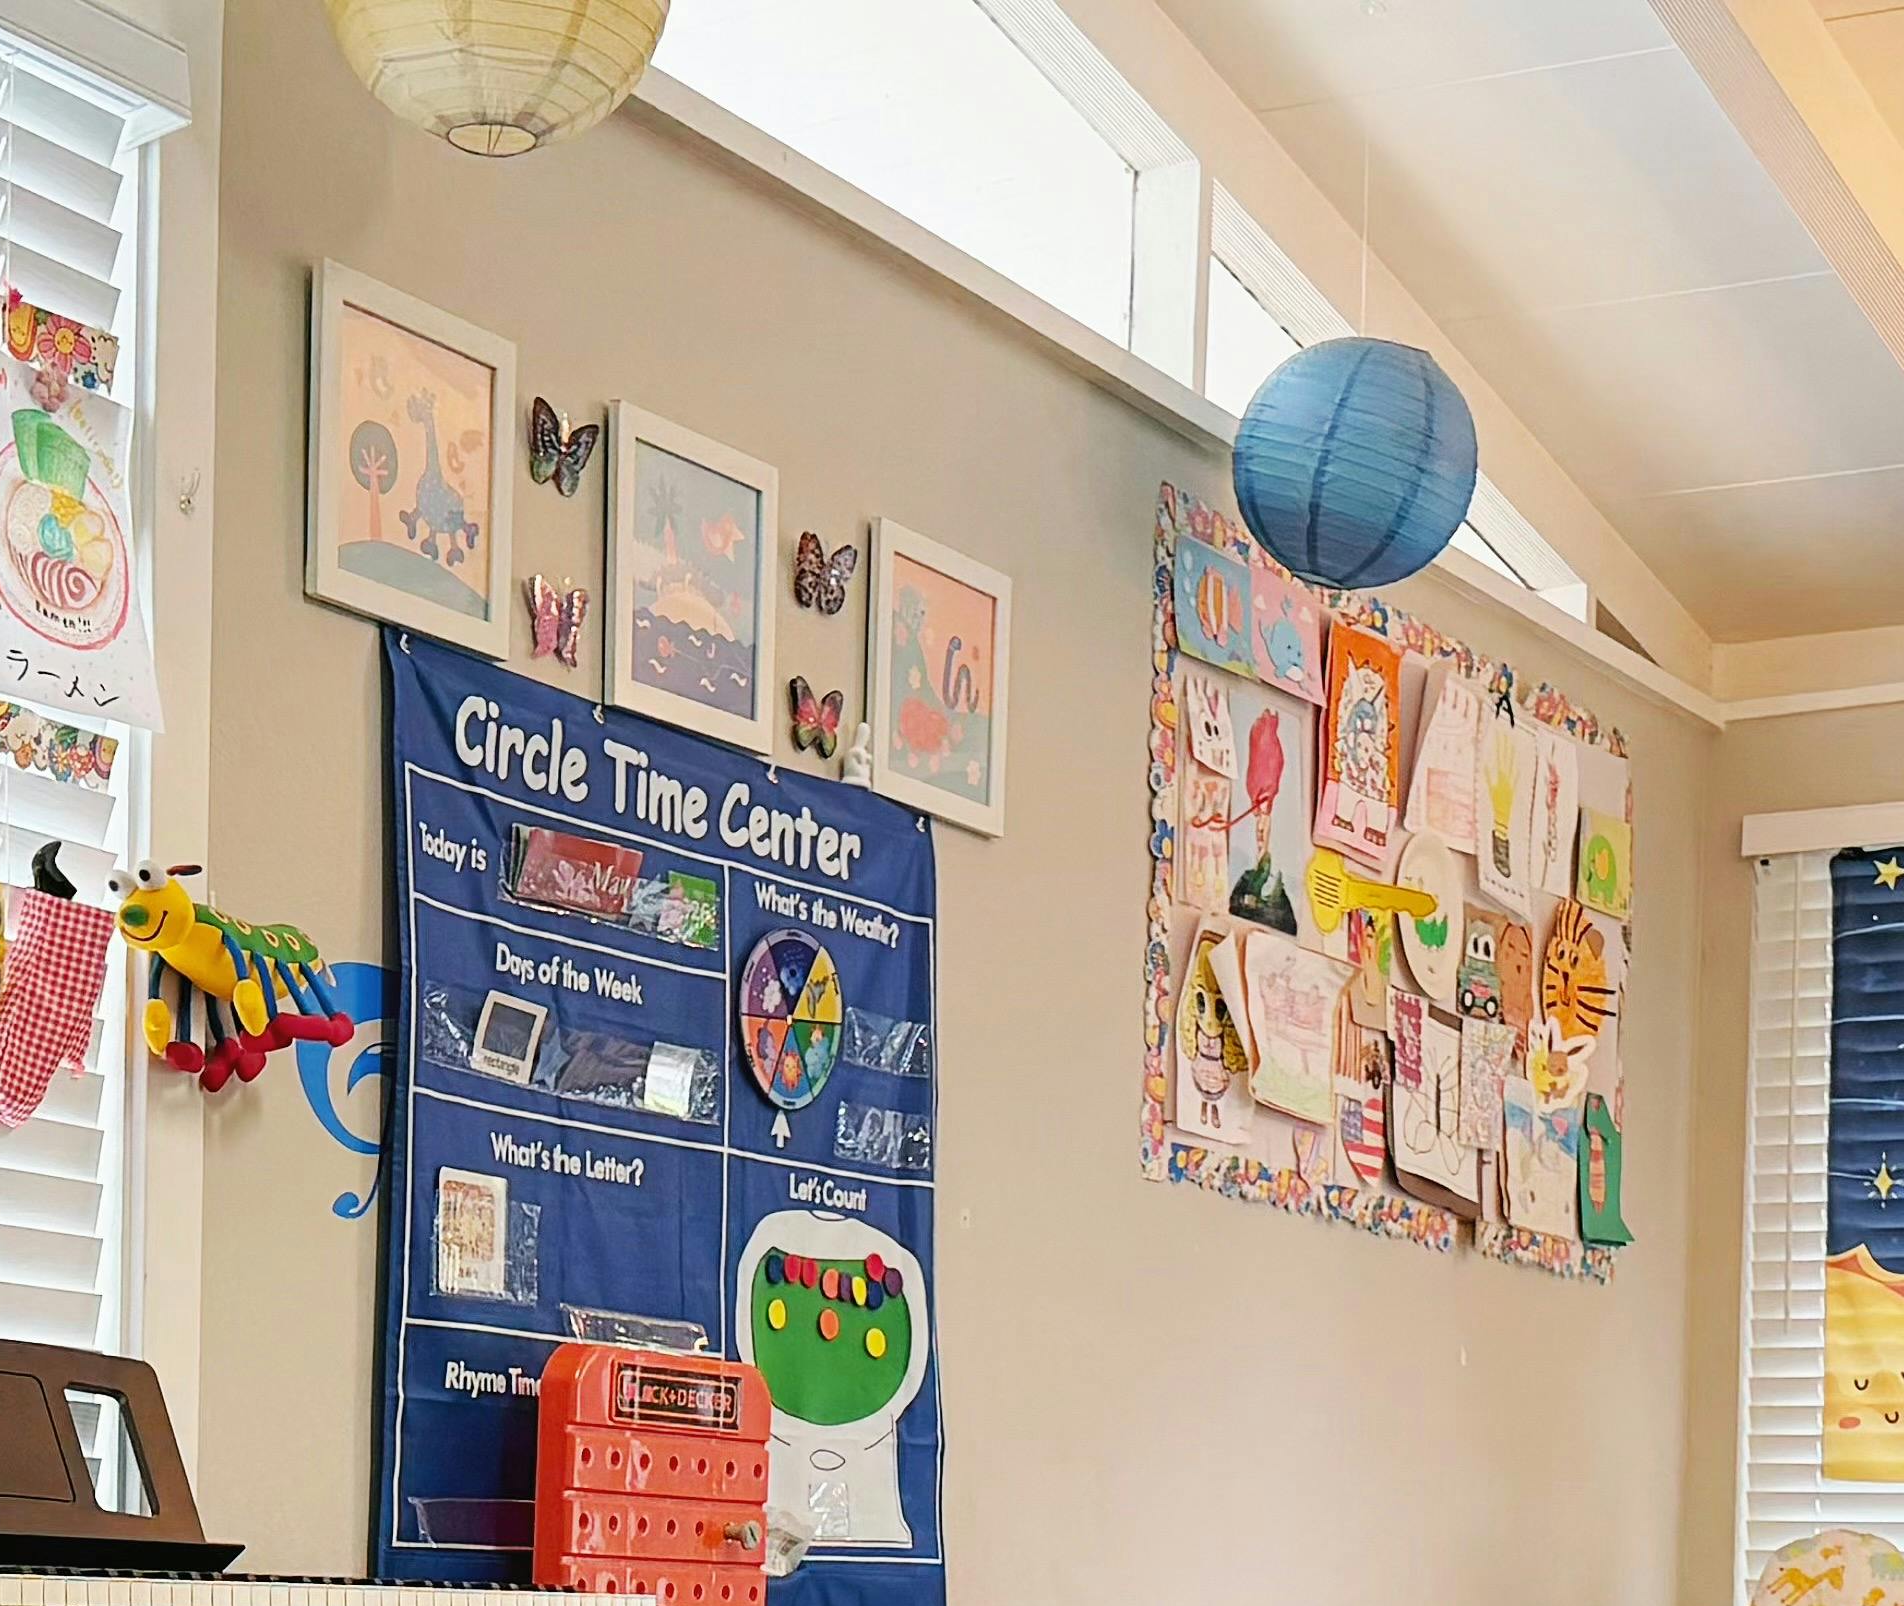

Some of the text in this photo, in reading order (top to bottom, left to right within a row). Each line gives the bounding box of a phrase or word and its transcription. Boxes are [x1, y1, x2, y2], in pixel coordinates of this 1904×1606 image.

[6, 649, 120, 707] ラーメン
[455, 695, 862, 881] Circle Time Center
[418, 822, 487, 873] Today is
[593, 861, 632, 905] May
[754, 881, 808, 921] What's
[811, 899, 837, 929] the
[496, 942, 643, 1005] Days of the Week
[490, 1132, 645, 1186] What's the Letter?
[789, 1173, 867, 1211] Let's Count
[445, 1361, 507, 1399] Rhyme
